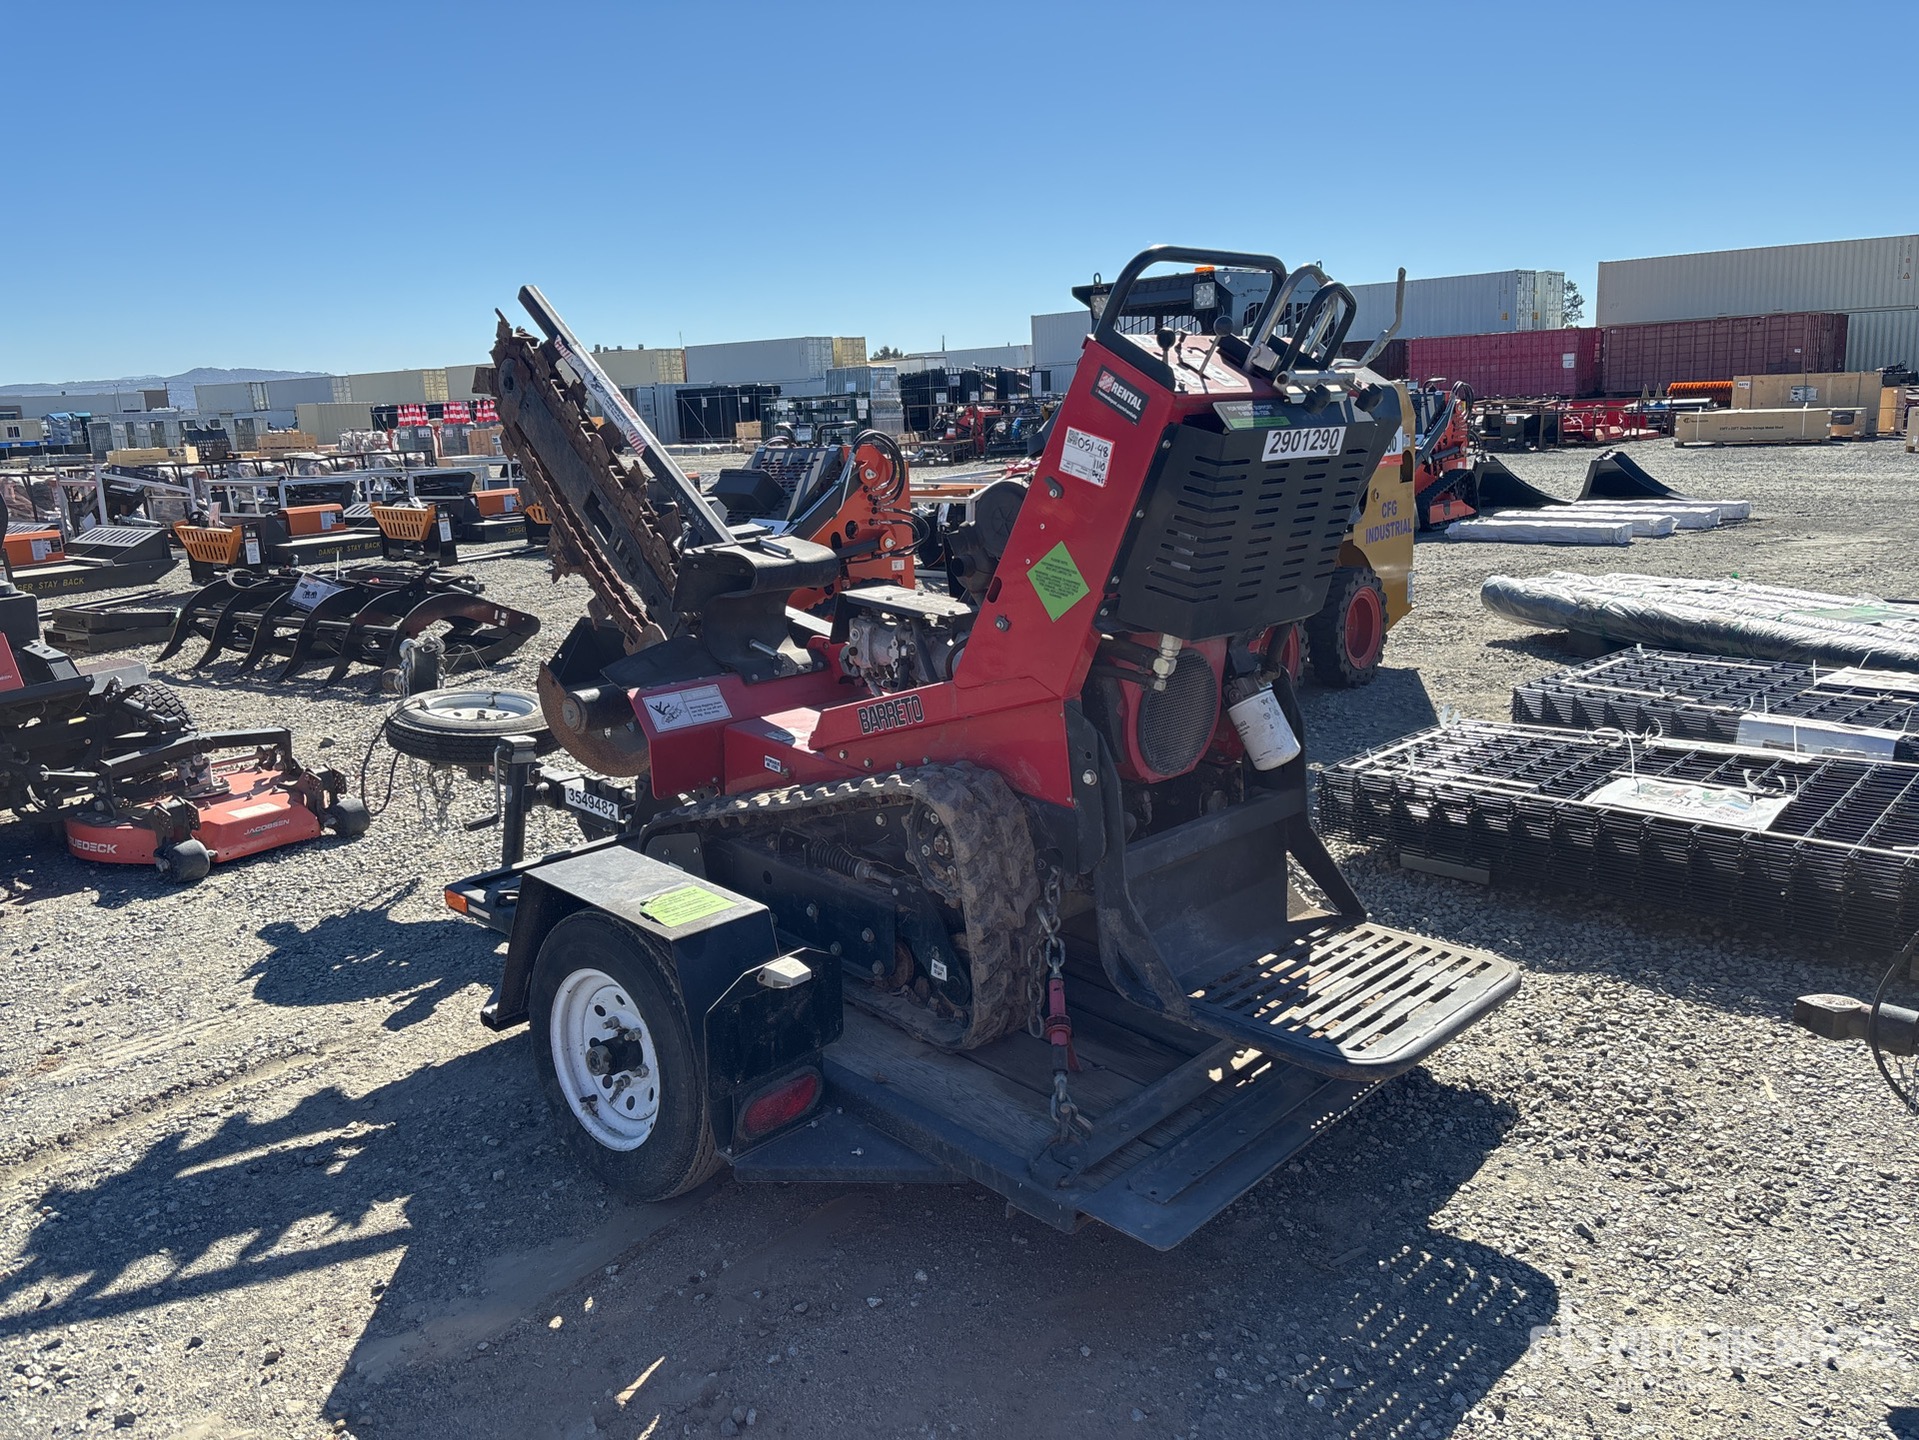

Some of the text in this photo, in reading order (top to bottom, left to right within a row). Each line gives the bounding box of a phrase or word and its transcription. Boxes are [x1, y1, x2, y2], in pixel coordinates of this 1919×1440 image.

[1111, 382, 1142, 411] RENTAL
[1269, 428, 1340, 454] 2901290
[1382, 500, 1398, 518] CFG
[1366, 518, 1412, 544] INDUSTRIAL
[347, 544, 362, 552] STAY
[364, 541, 381, 550] BACK
[39, 580, 58, 590] STAY
[62, 577, 85, 587] BACK
[857, 694, 924, 735] BARRETO
[569, 788, 616, 817] 3549482
[243, 819, 290, 835] JACOBSEN
